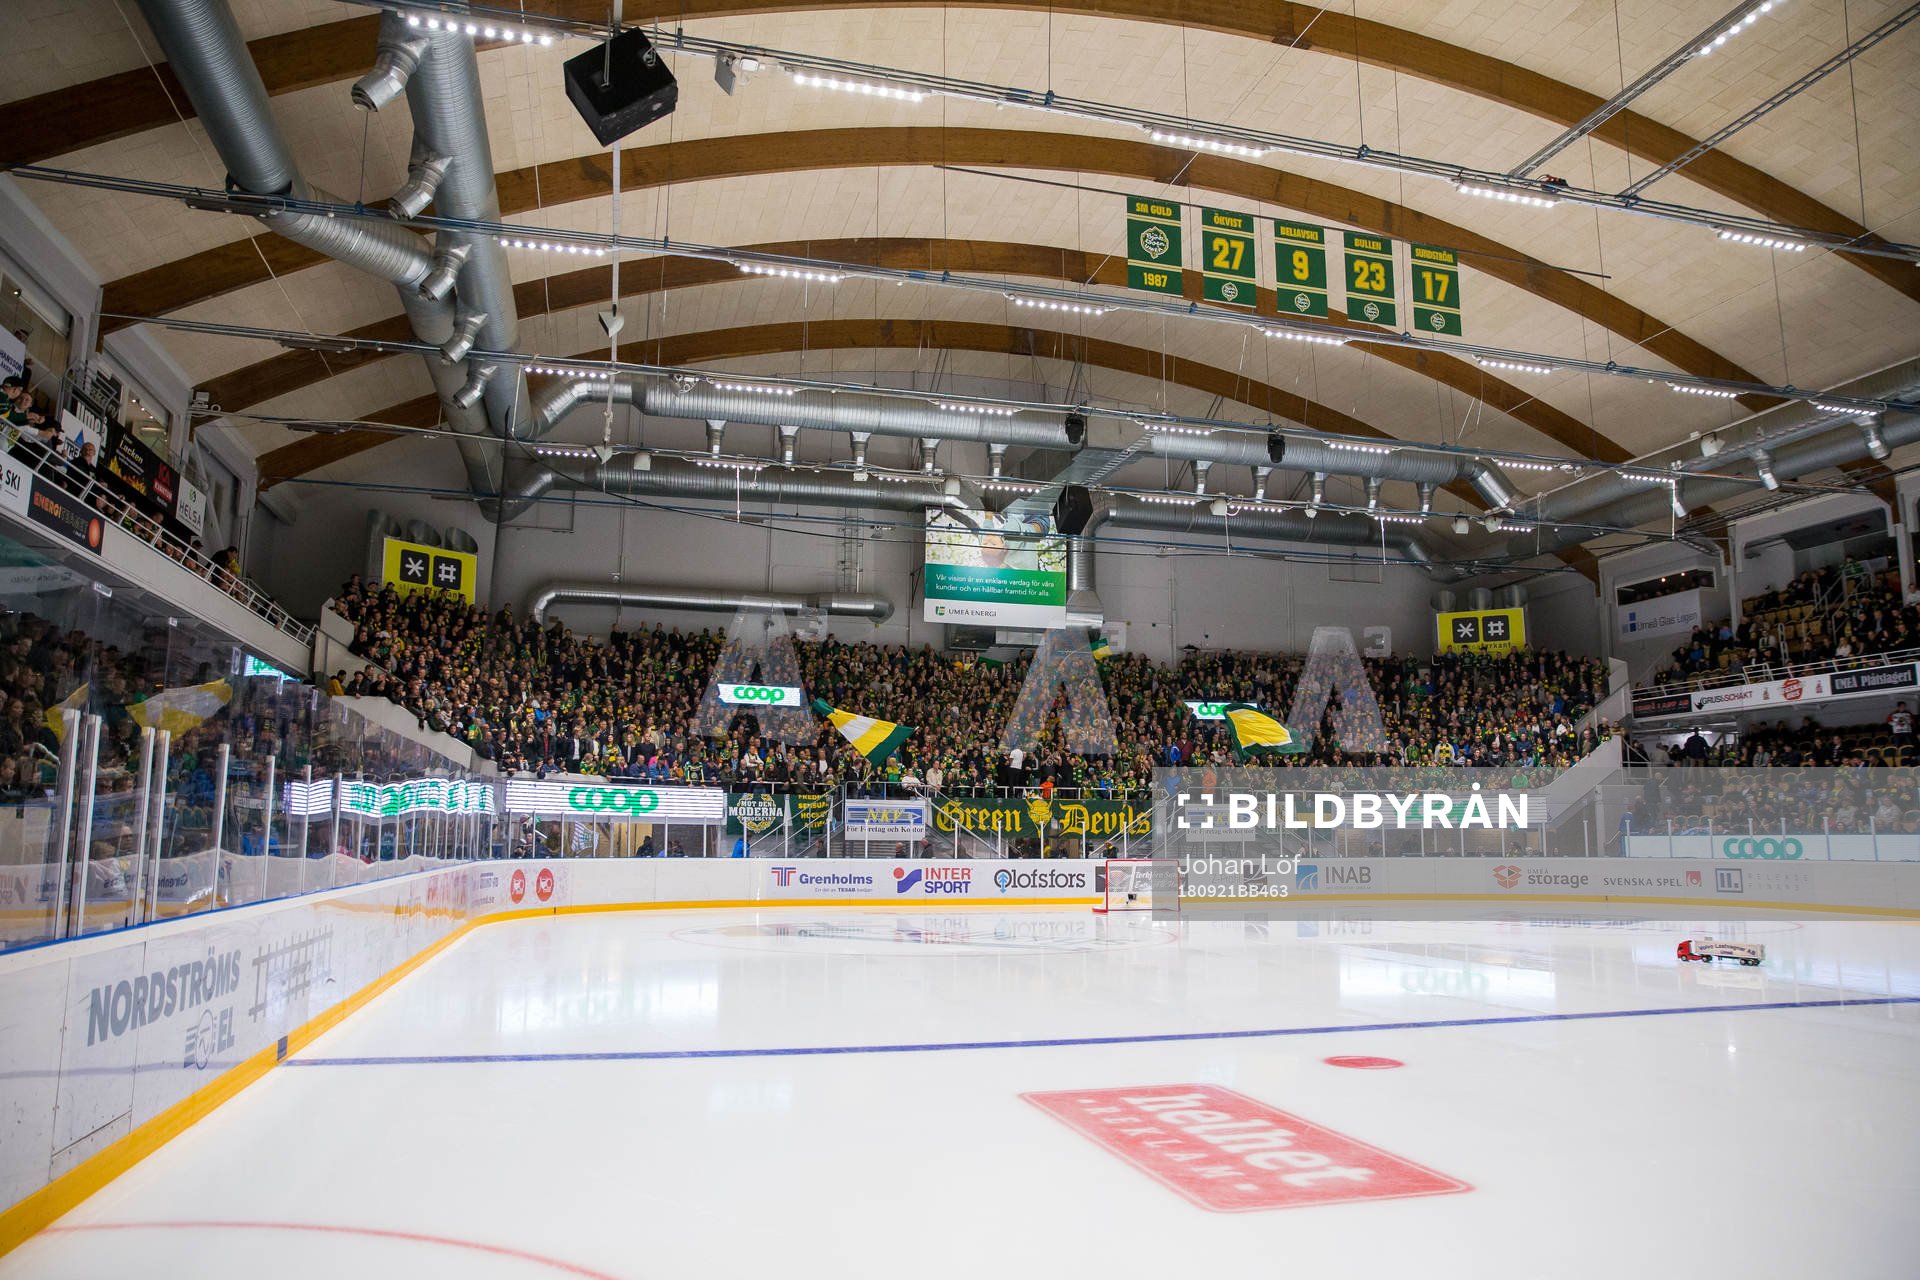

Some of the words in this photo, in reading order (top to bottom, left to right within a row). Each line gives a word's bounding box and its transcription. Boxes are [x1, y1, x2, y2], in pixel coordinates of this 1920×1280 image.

[1136, 202, 1149, 214] SM
[1150, 204, 1172, 217] GULD
[1212, 213, 1242, 229] ÖKVIST
[1354, 236, 1382, 250] BULLEN
[1212, 238, 1245, 271] 27
[1292, 250, 1310, 281] 9
[1143, 272, 1168, 288] 1987
[1354, 259, 1386, 291] 23
[1421, 271, 1450, 302] 17
[6, 469, 20, 492] SKI
[948, 608, 970, 616] UMEÅ
[733, 686, 785, 704] coop
[568, 786, 659, 817] coop
[741, 800, 756, 808] MOT
[728, 806, 784, 818] MODERNA
[936, 799, 1022, 835] Green
[1054, 801, 1152, 838] Devils
[888, 826, 898, 834] och
[901, 826, 924, 834] Kotor
[1723, 837, 1804, 860] coop
[800, 874, 873, 885] Grenholms
[925, 868, 972, 880] INTER
[994, 868, 1086, 890] Olofsfors
[1326, 866, 1372, 884] INAB
[1528, 873, 1589, 888] storage
[1604, 877, 1653, 887] SVENSKA
[1656, 878, 1683, 887] SPEL
[924, 880, 971, 894] SPORT
[86, 946, 241, 1047] NORDSTRÖMS
[218, 1006, 235, 1055] EL
[1088, 1105, 1247, 1181] REKLAM
[1125, 1092, 1379, 1186] helhet
